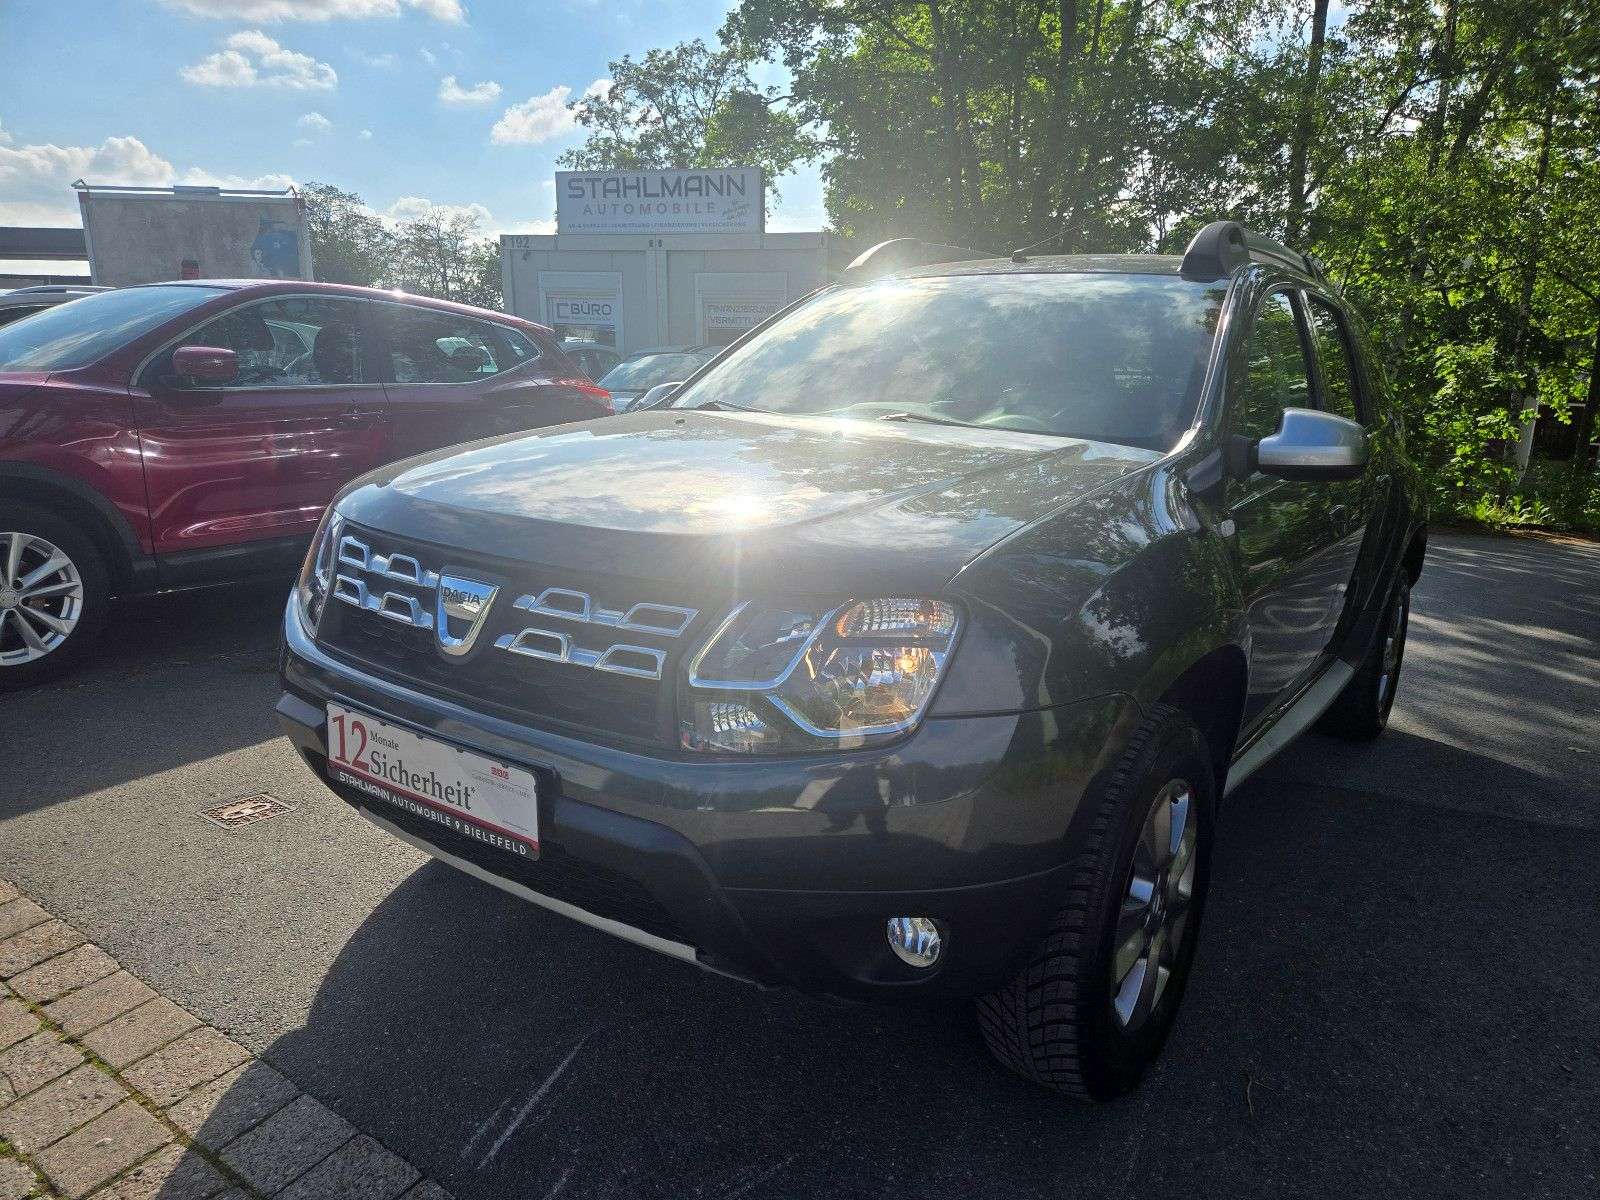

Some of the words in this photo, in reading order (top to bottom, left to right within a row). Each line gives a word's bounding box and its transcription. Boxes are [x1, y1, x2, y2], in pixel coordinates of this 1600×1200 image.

[567, 174, 746, 199] STAHLMANN
[583, 202, 717, 216] AUTOMOBILE
[510, 237, 530, 249] 192
[570, 301, 612, 316] BÜRO
[443, 586, 481, 604] DACIA
[332, 714, 369, 772] 12
[370, 730, 400, 751] Monate
[339, 772, 390, 800] STAHLMANN
[392, 795, 451, 826] AUTOMOBILE
[464, 825, 527, 855] BIELEFELD
